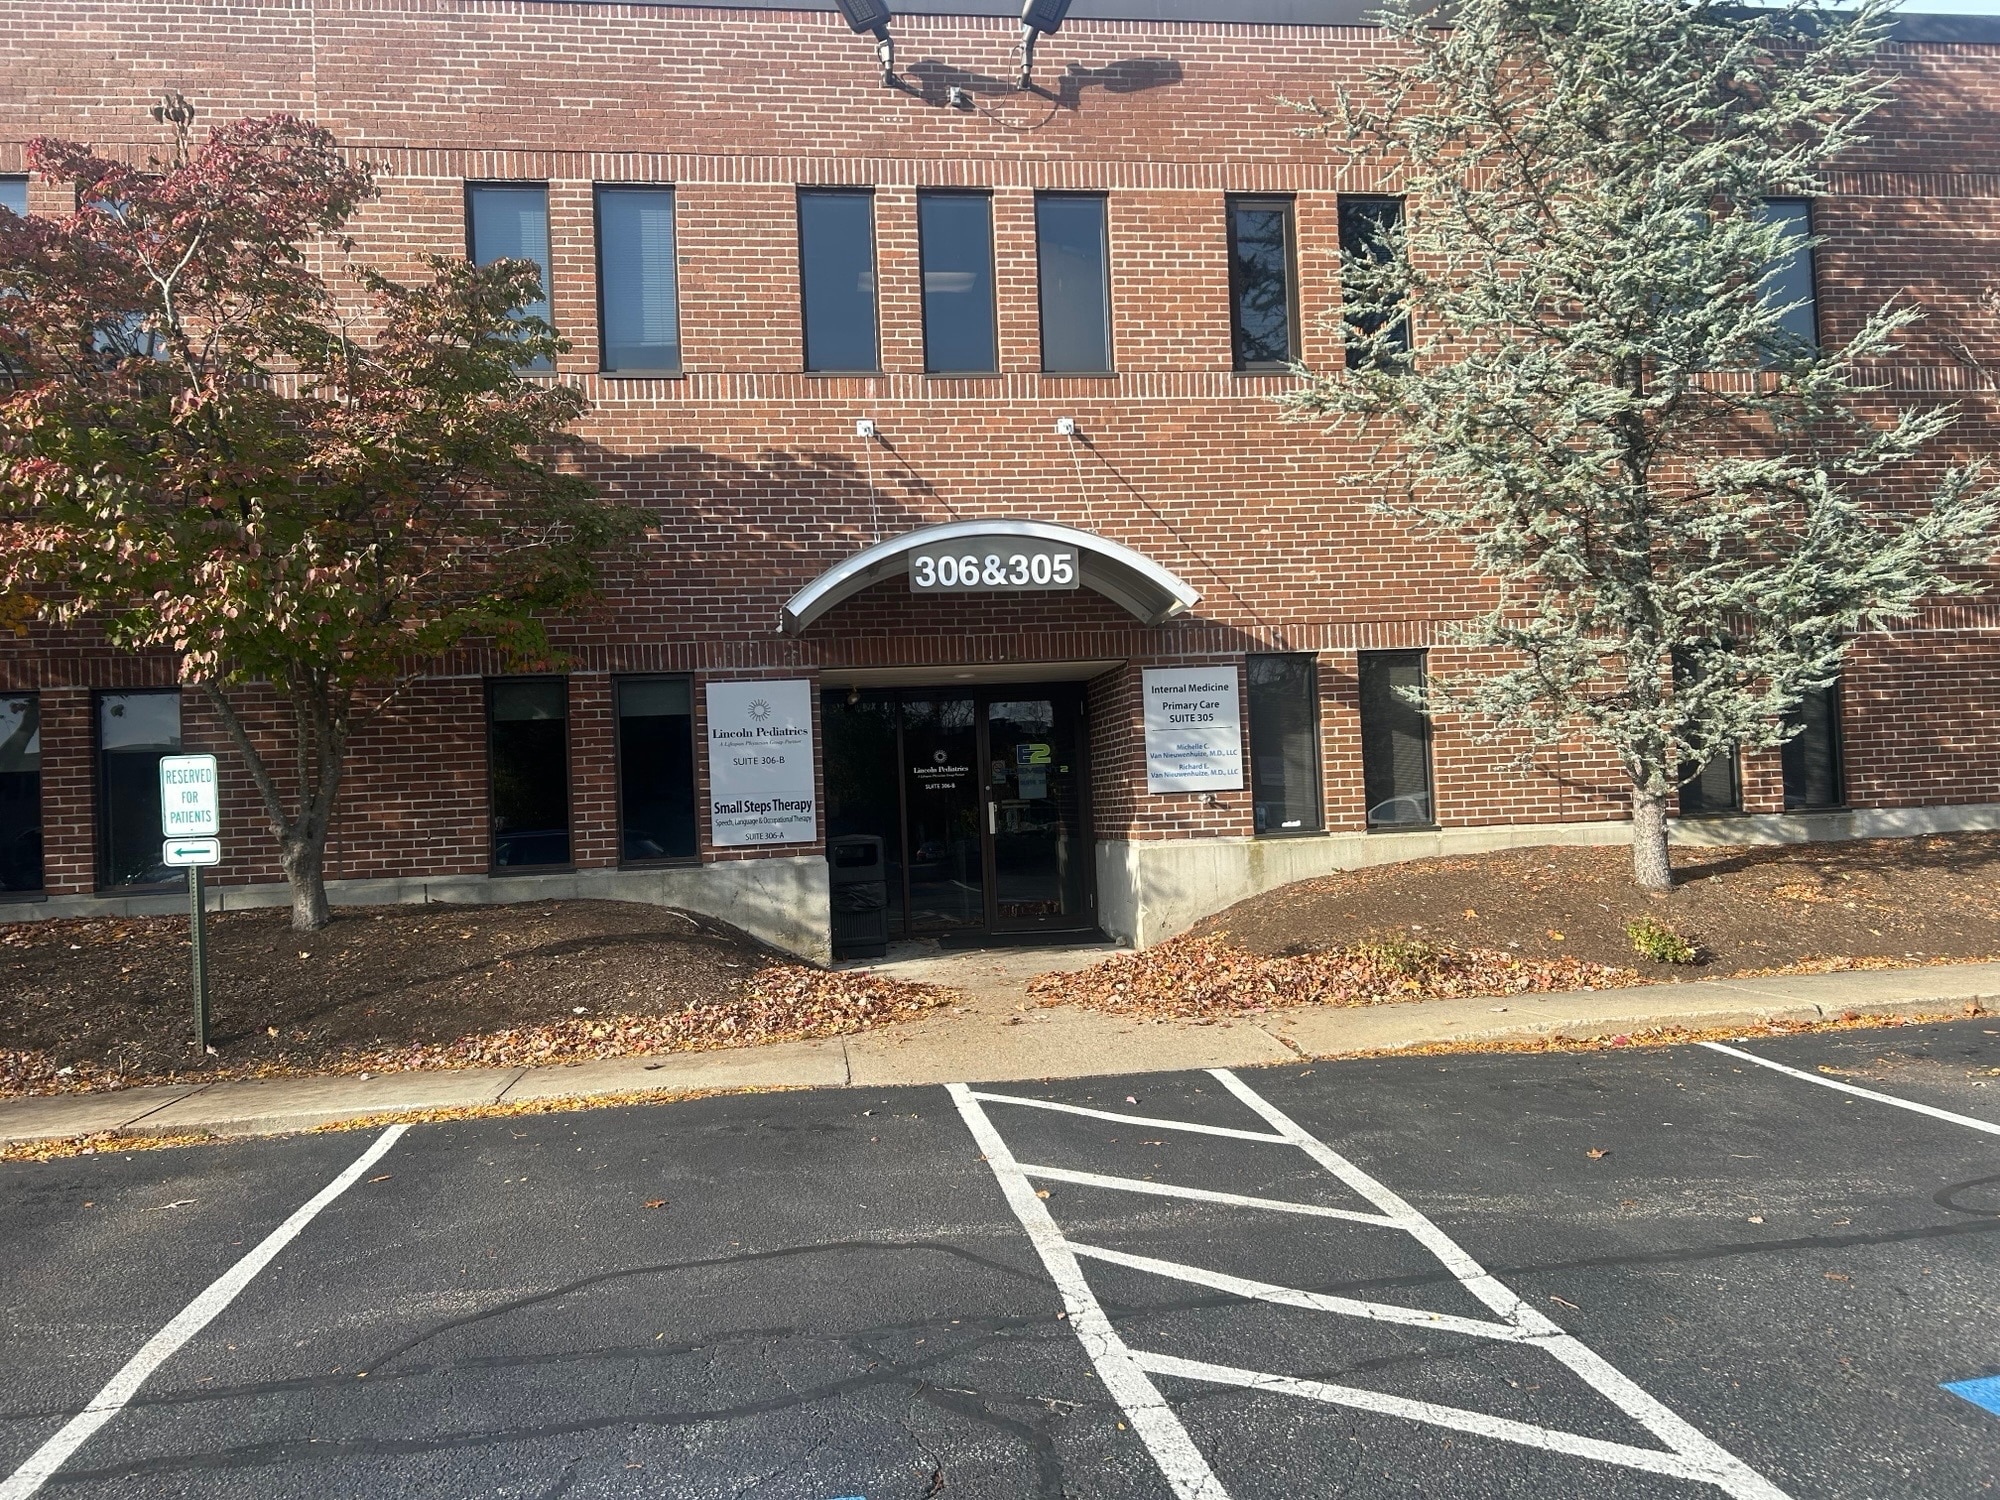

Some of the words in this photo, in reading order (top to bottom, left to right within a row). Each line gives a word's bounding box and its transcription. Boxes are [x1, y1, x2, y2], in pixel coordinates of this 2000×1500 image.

[915, 553, 1074, 587] 306&305
[1151, 684, 1187, 694] Internal
[1189, 682, 1229, 693] Medicine
[1162, 701, 1198, 711] Primary
[1199, 700, 1220, 709] Care
[1169, 714, 1196, 723] SUITE
[1197, 713, 1214, 722] 305
[712, 728, 753, 739] Lincoln
[756, 726, 808, 737] Pediatrics
[733, 757, 758, 766] SUITE
[761, 756, 785, 765] 306-B
[913, 766, 937, 774] Lincoln
[938, 765, 969, 773] Pediatrics
[166, 768, 212, 785] RESERVED
[181, 791, 198, 804] FOR
[714, 800, 742, 814] Small
[744, 800, 771, 815] Steps
[772, 799, 812, 813] Therapy
[170, 810, 212, 824] PATIENTS
[715, 818, 734, 827] Speech,
[734, 817, 758, 827] Language
[764, 815, 794, 825] Occupational
[794, 815, 812, 823] Therapy
[745, 833, 763, 841] SUITE
[765, 831, 785, 840] 306-A
